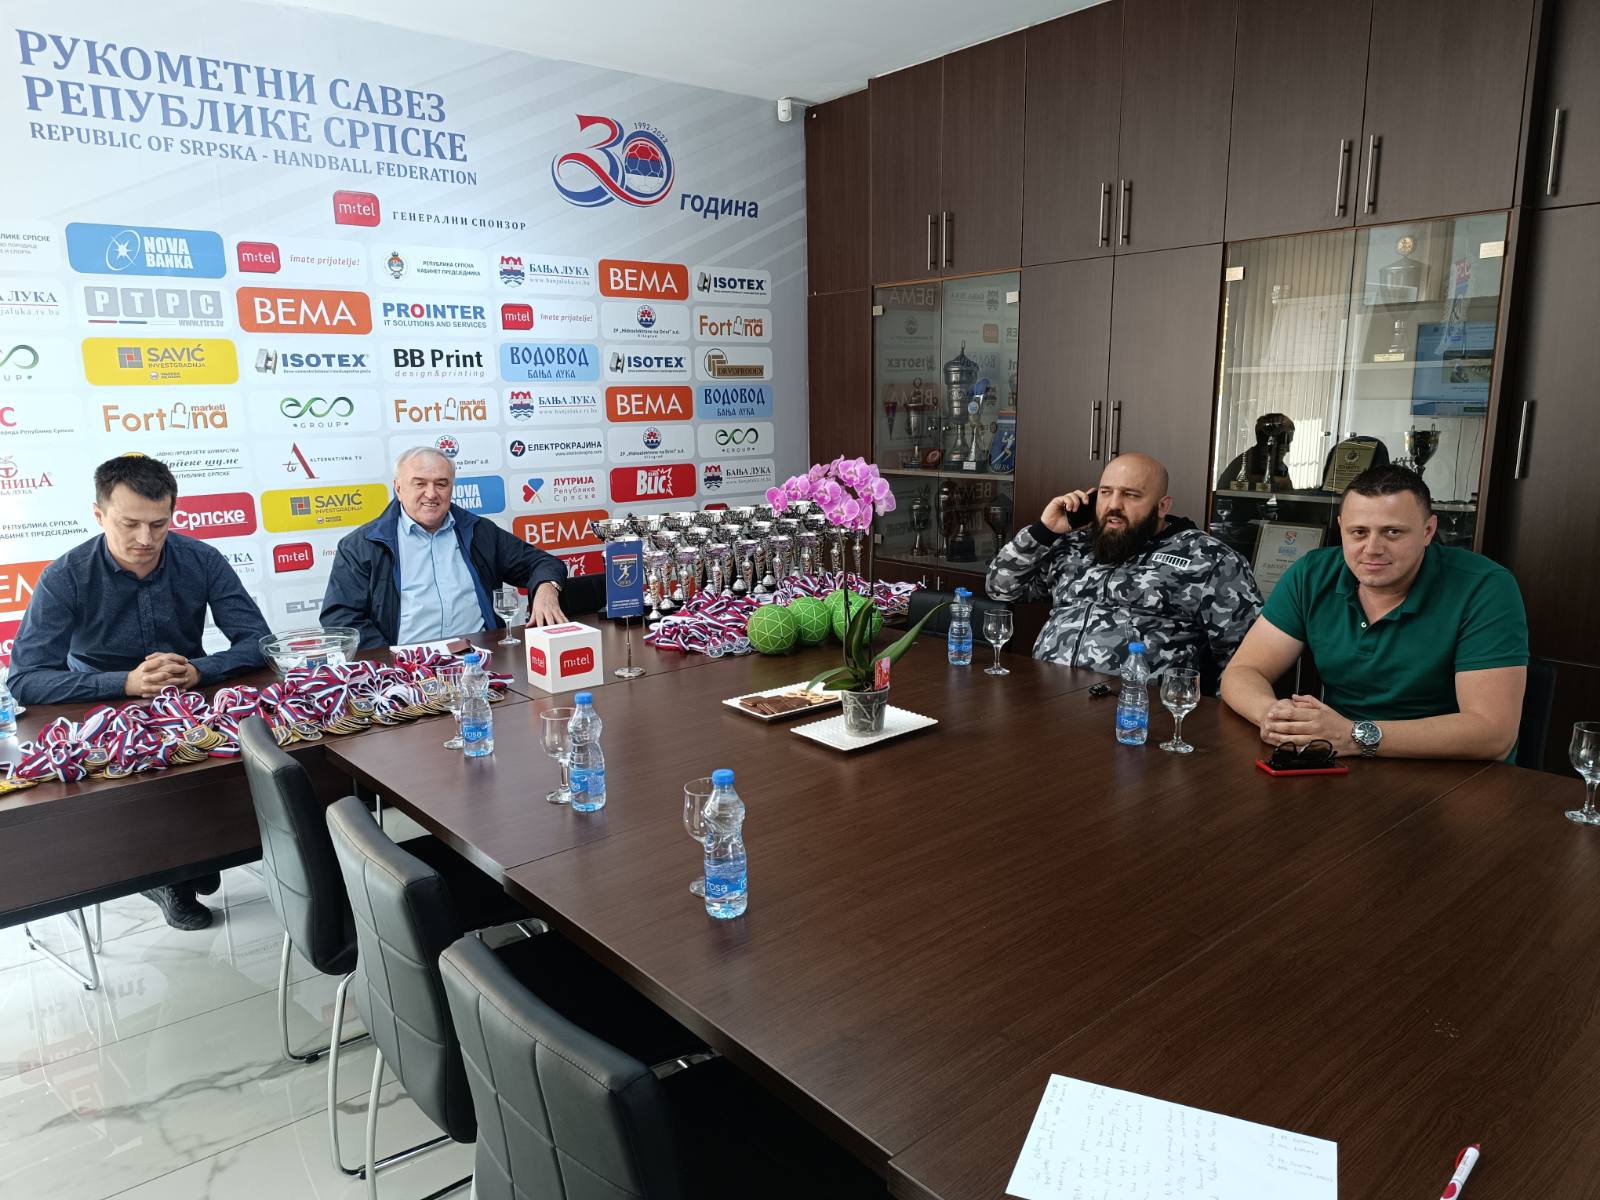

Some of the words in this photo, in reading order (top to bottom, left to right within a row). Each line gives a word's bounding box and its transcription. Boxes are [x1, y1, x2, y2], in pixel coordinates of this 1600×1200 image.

[15, 29, 318, 106] РУКОМЕТНИ
[329, 78, 446, 123] САВЕЗ
[22, 75, 313, 144] РЕПУБЛИКЕ
[323, 116, 468, 162] СРПСКЕ
[29, 121, 143, 150] REPUBLIC
[147, 135, 174, 154] OF
[180, 139, 258, 162] SRPSKA
[274, 149, 372, 175] HANDBALL
[376, 161, 478, 186] FEDERATION
[338, 201, 376, 217] m:tel
[680, 193, 759, 220] година
[392, 210, 468, 226] ГЕНЕРАЛНИ
[471, 218, 527, 231] СПОНЗОР
[143, 236, 190, 255] NOVA
[145, 253, 194, 269] BANKA
[242, 250, 276, 264] m:tel
[529, 263, 559, 274] БАЊА
[560, 265, 589, 276] ЛУКА
[713, 277, 765, 290] ISOTEX
[8, 290, 58, 303] ЛУКА
[382, 302, 486, 320] PROINTER
[393, 320, 435, 328] SOLUTIONS
[452, 321, 487, 329] SERVICES
[147, 344, 205, 362] SAVIĆ
[281, 353, 367, 368] ISOTEX
[393, 348, 425, 368] BB
[431, 348, 484, 368] Print
[510, 346, 590, 367] ВОДОВОД
[627, 356, 684, 368] ISOTEX
[527, 369, 552, 379] БАЊА
[538, 396, 568, 405] БАЊА
[569, 395, 597, 405] ЛУКА
[704, 387, 766, 406] ВОДОВОД
[190, 403, 226, 412] marketi
[527, 441, 603, 452] ЕЛЕКТРОКРАЈИНА
[726, 468, 750, 477] БАЊА
[750, 466, 772, 476] ЛУКА
[553, 476, 594, 487] ЛУТРИЈА
[314, 489, 362, 508] SAVIĆ
[554, 487, 596, 495] Републике
[49, 519, 79, 528] СРПСКА
[172, 509, 246, 531] Српске
[277, 550, 309, 563] m:tel
[563, 653, 590, 668] m:tel
[706, 881, 728, 892] rosa
